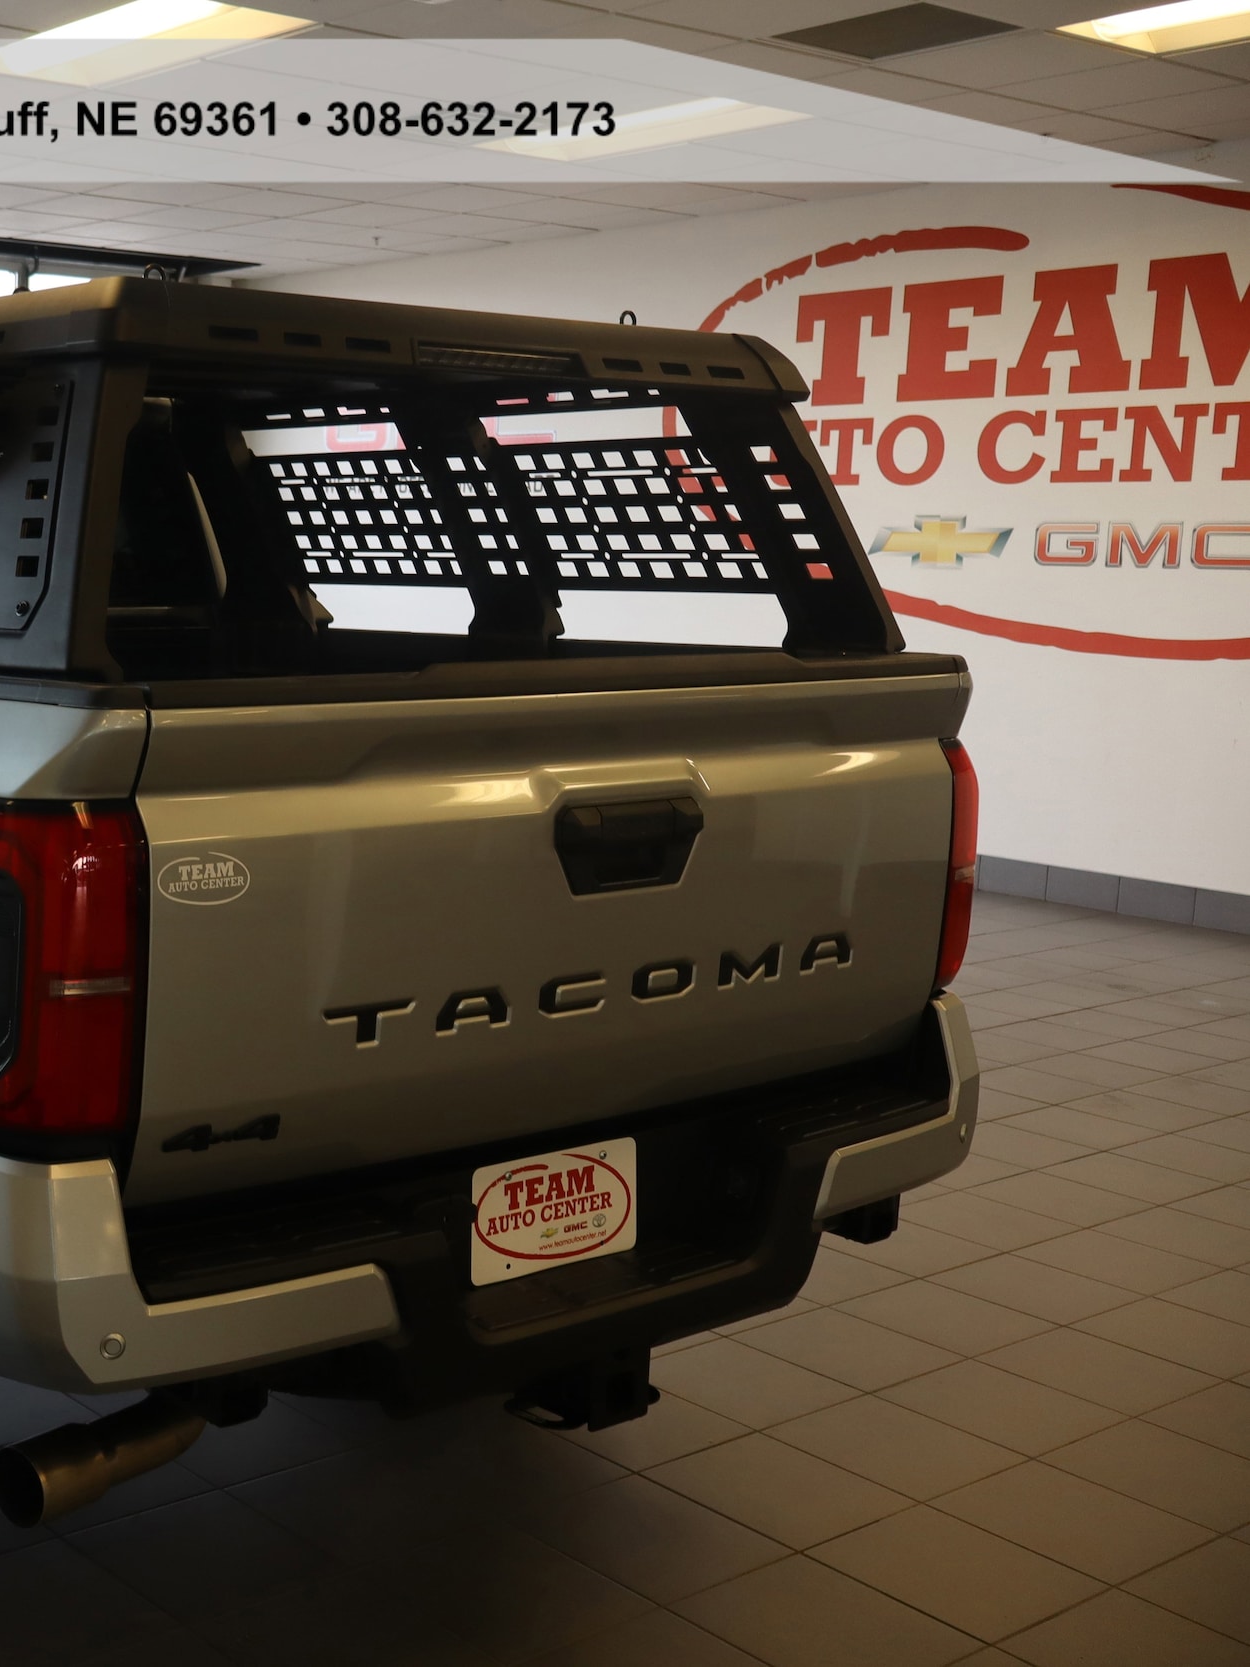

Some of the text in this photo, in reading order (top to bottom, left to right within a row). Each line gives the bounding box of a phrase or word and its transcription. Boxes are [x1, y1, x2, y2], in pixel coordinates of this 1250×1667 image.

[1034, 520, 1250, 570] GMC
[168, 876, 245, 894] AUTO CENTER
[178, 861, 235, 881] TEAM
[321, 931, 853, 1049] TACOMA
[504, 1164, 595, 1212] TEAM
[486, 1191, 613, 1237] AUTO CENTER
[563, 1221, 588, 1234] GMC
